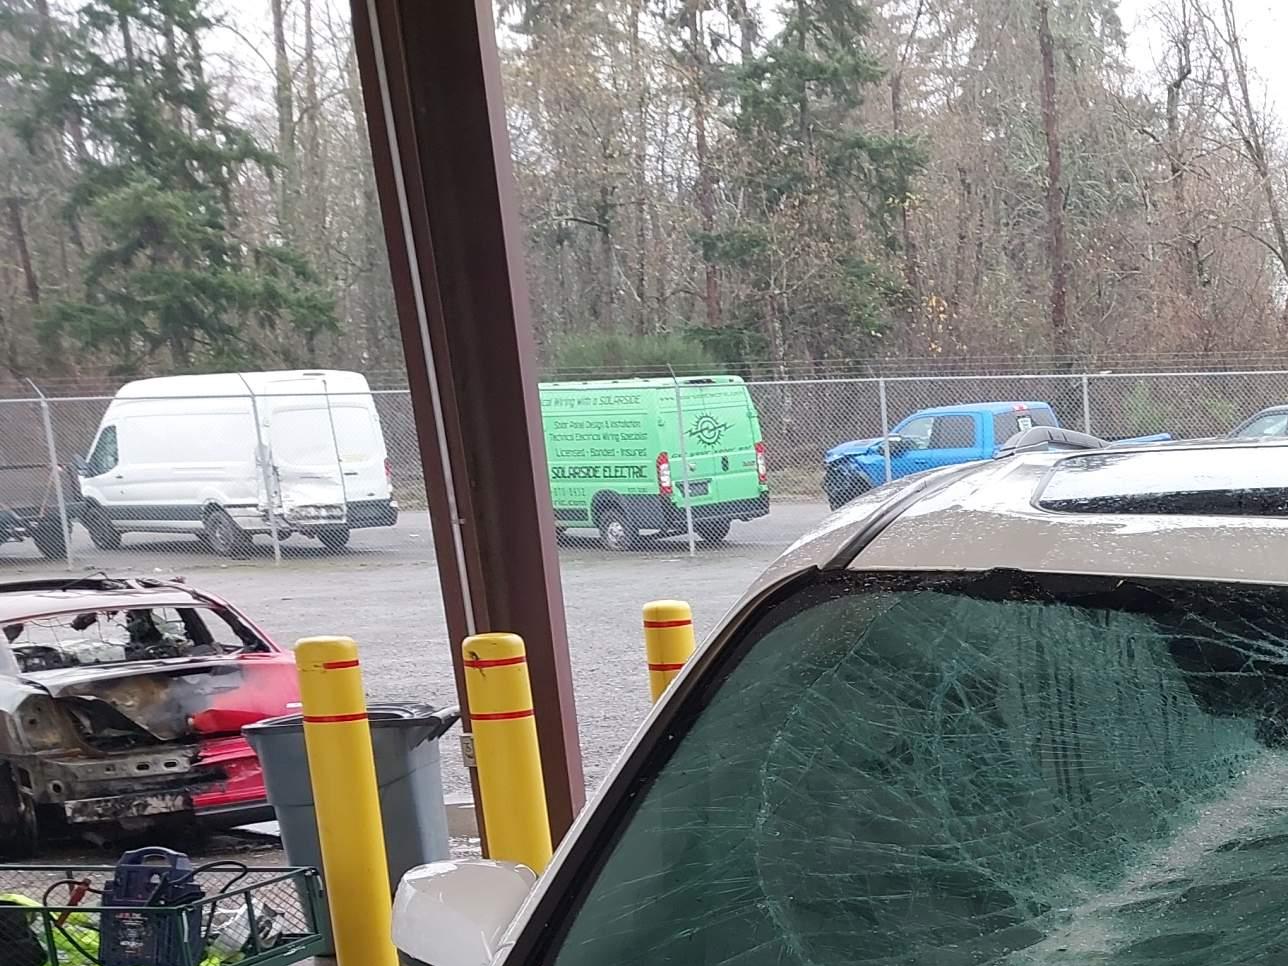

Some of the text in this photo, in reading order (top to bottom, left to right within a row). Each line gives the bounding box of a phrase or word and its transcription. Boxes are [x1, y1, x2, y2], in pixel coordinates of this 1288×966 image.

[599, 394, 640, 405] SOLARSIDE
[586, 420, 603, 430] Design
[611, 420, 640, 429] Installation
[549, 432, 647, 442] Technical Electrical Wiring Specialist
[556, 448, 585, 457] Licensed
[590, 448, 615, 457] Bonded
[620, 447, 647, 457] Insured
[552, 465, 648, 479] SOLARSIDE ELECTRIC
